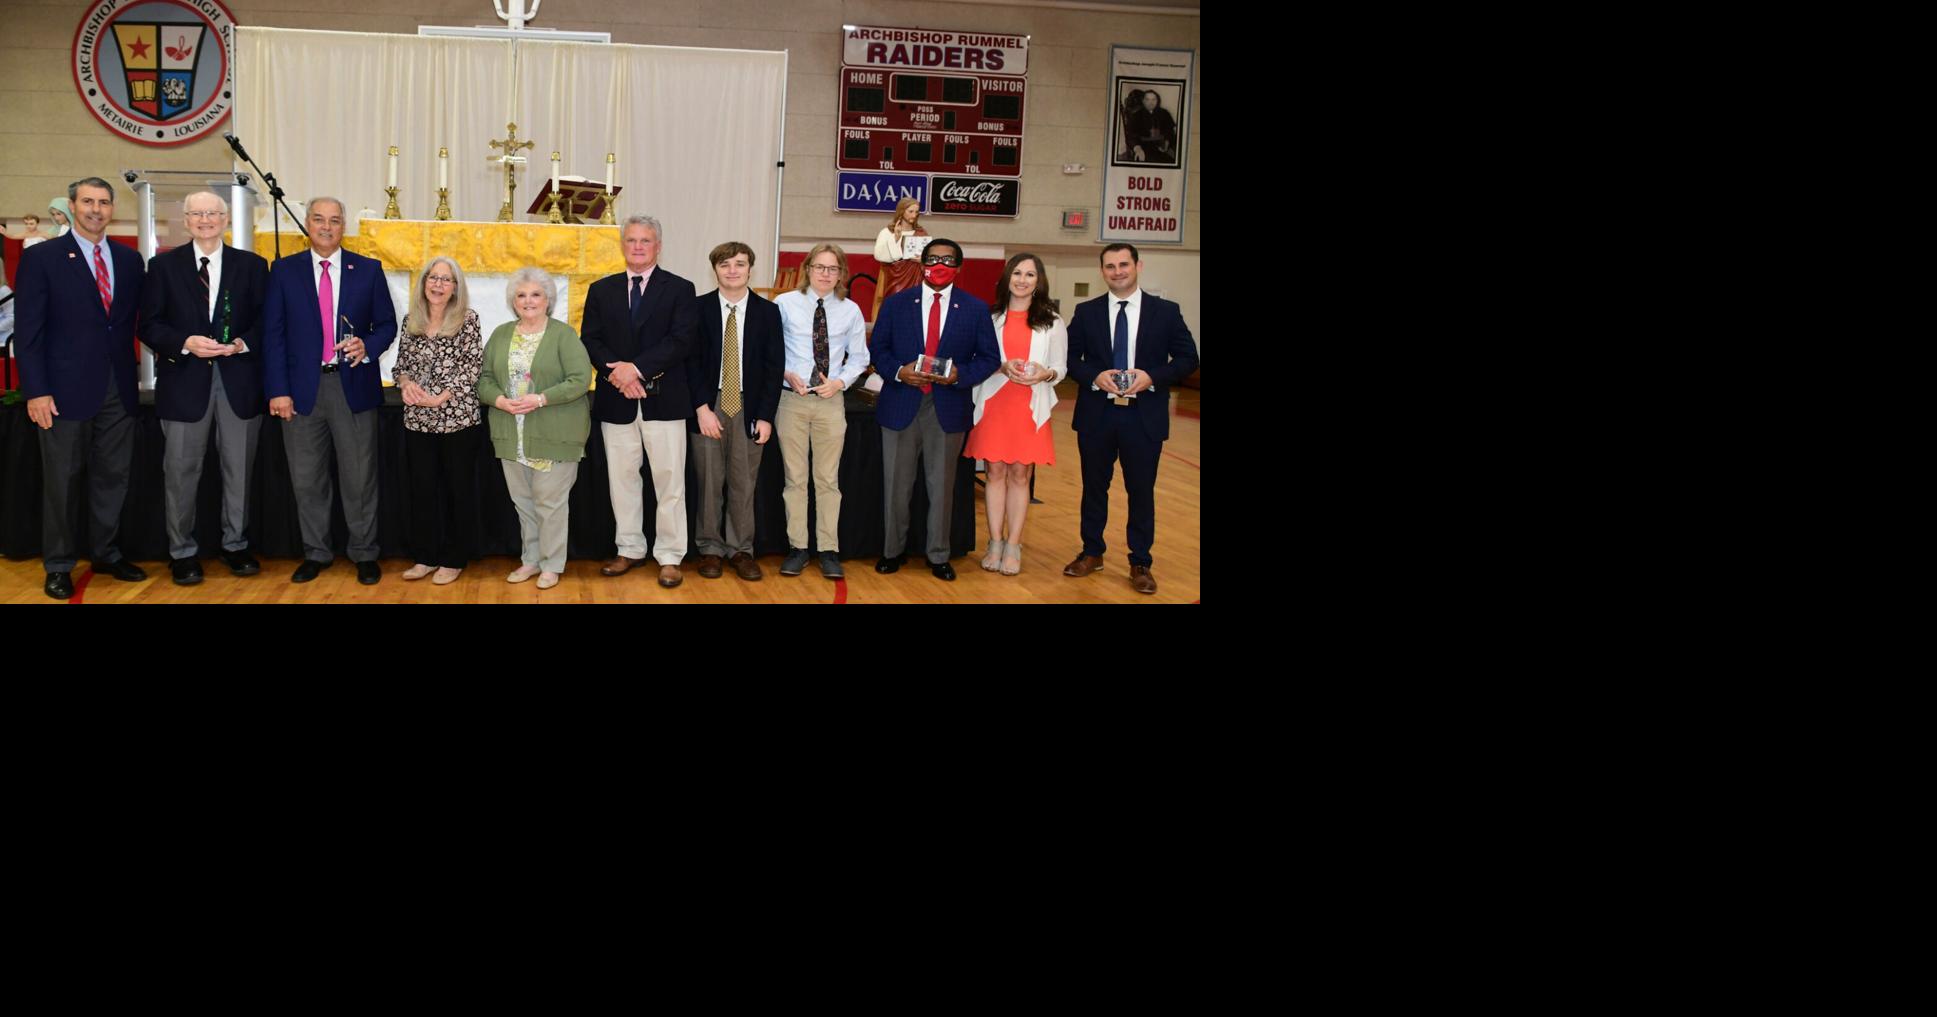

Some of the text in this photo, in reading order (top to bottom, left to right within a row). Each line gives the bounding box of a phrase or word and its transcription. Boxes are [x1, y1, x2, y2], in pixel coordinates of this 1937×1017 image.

[80, 0, 116, 82] ARCHBISHOP
[848, 29, 1024, 49] ARCHBISHOP RUMMEL
[866, 42, 1005, 71] RAIDERS
[850, 72, 883, 85] HOME
[981, 79, 1023, 93] VISITOR
[98, 103, 144, 136] METAIRIE
[174, 103, 225, 137] LOUISIANA
[860, 116, 888, 126] BONUS
[910, 112, 940, 123] PERIOD
[977, 122, 1005, 132] BONUS
[844, 130, 870, 139] FOULS
[902, 133, 932, 143] PLAYER
[944, 135, 970, 145] FOULS
[992, 137, 1018, 147] FOULS
[879, 161, 894, 170] TOL
[965, 165, 981, 174] TOL
[1128, 176, 1163, 192] BOLD
[843, 179, 922, 205] DASANI
[940, 180, 1004, 203] Coca-Cola
[1116, 196, 1171, 212] STRONG
[1108, 216, 1177, 232] UNAFRAID
